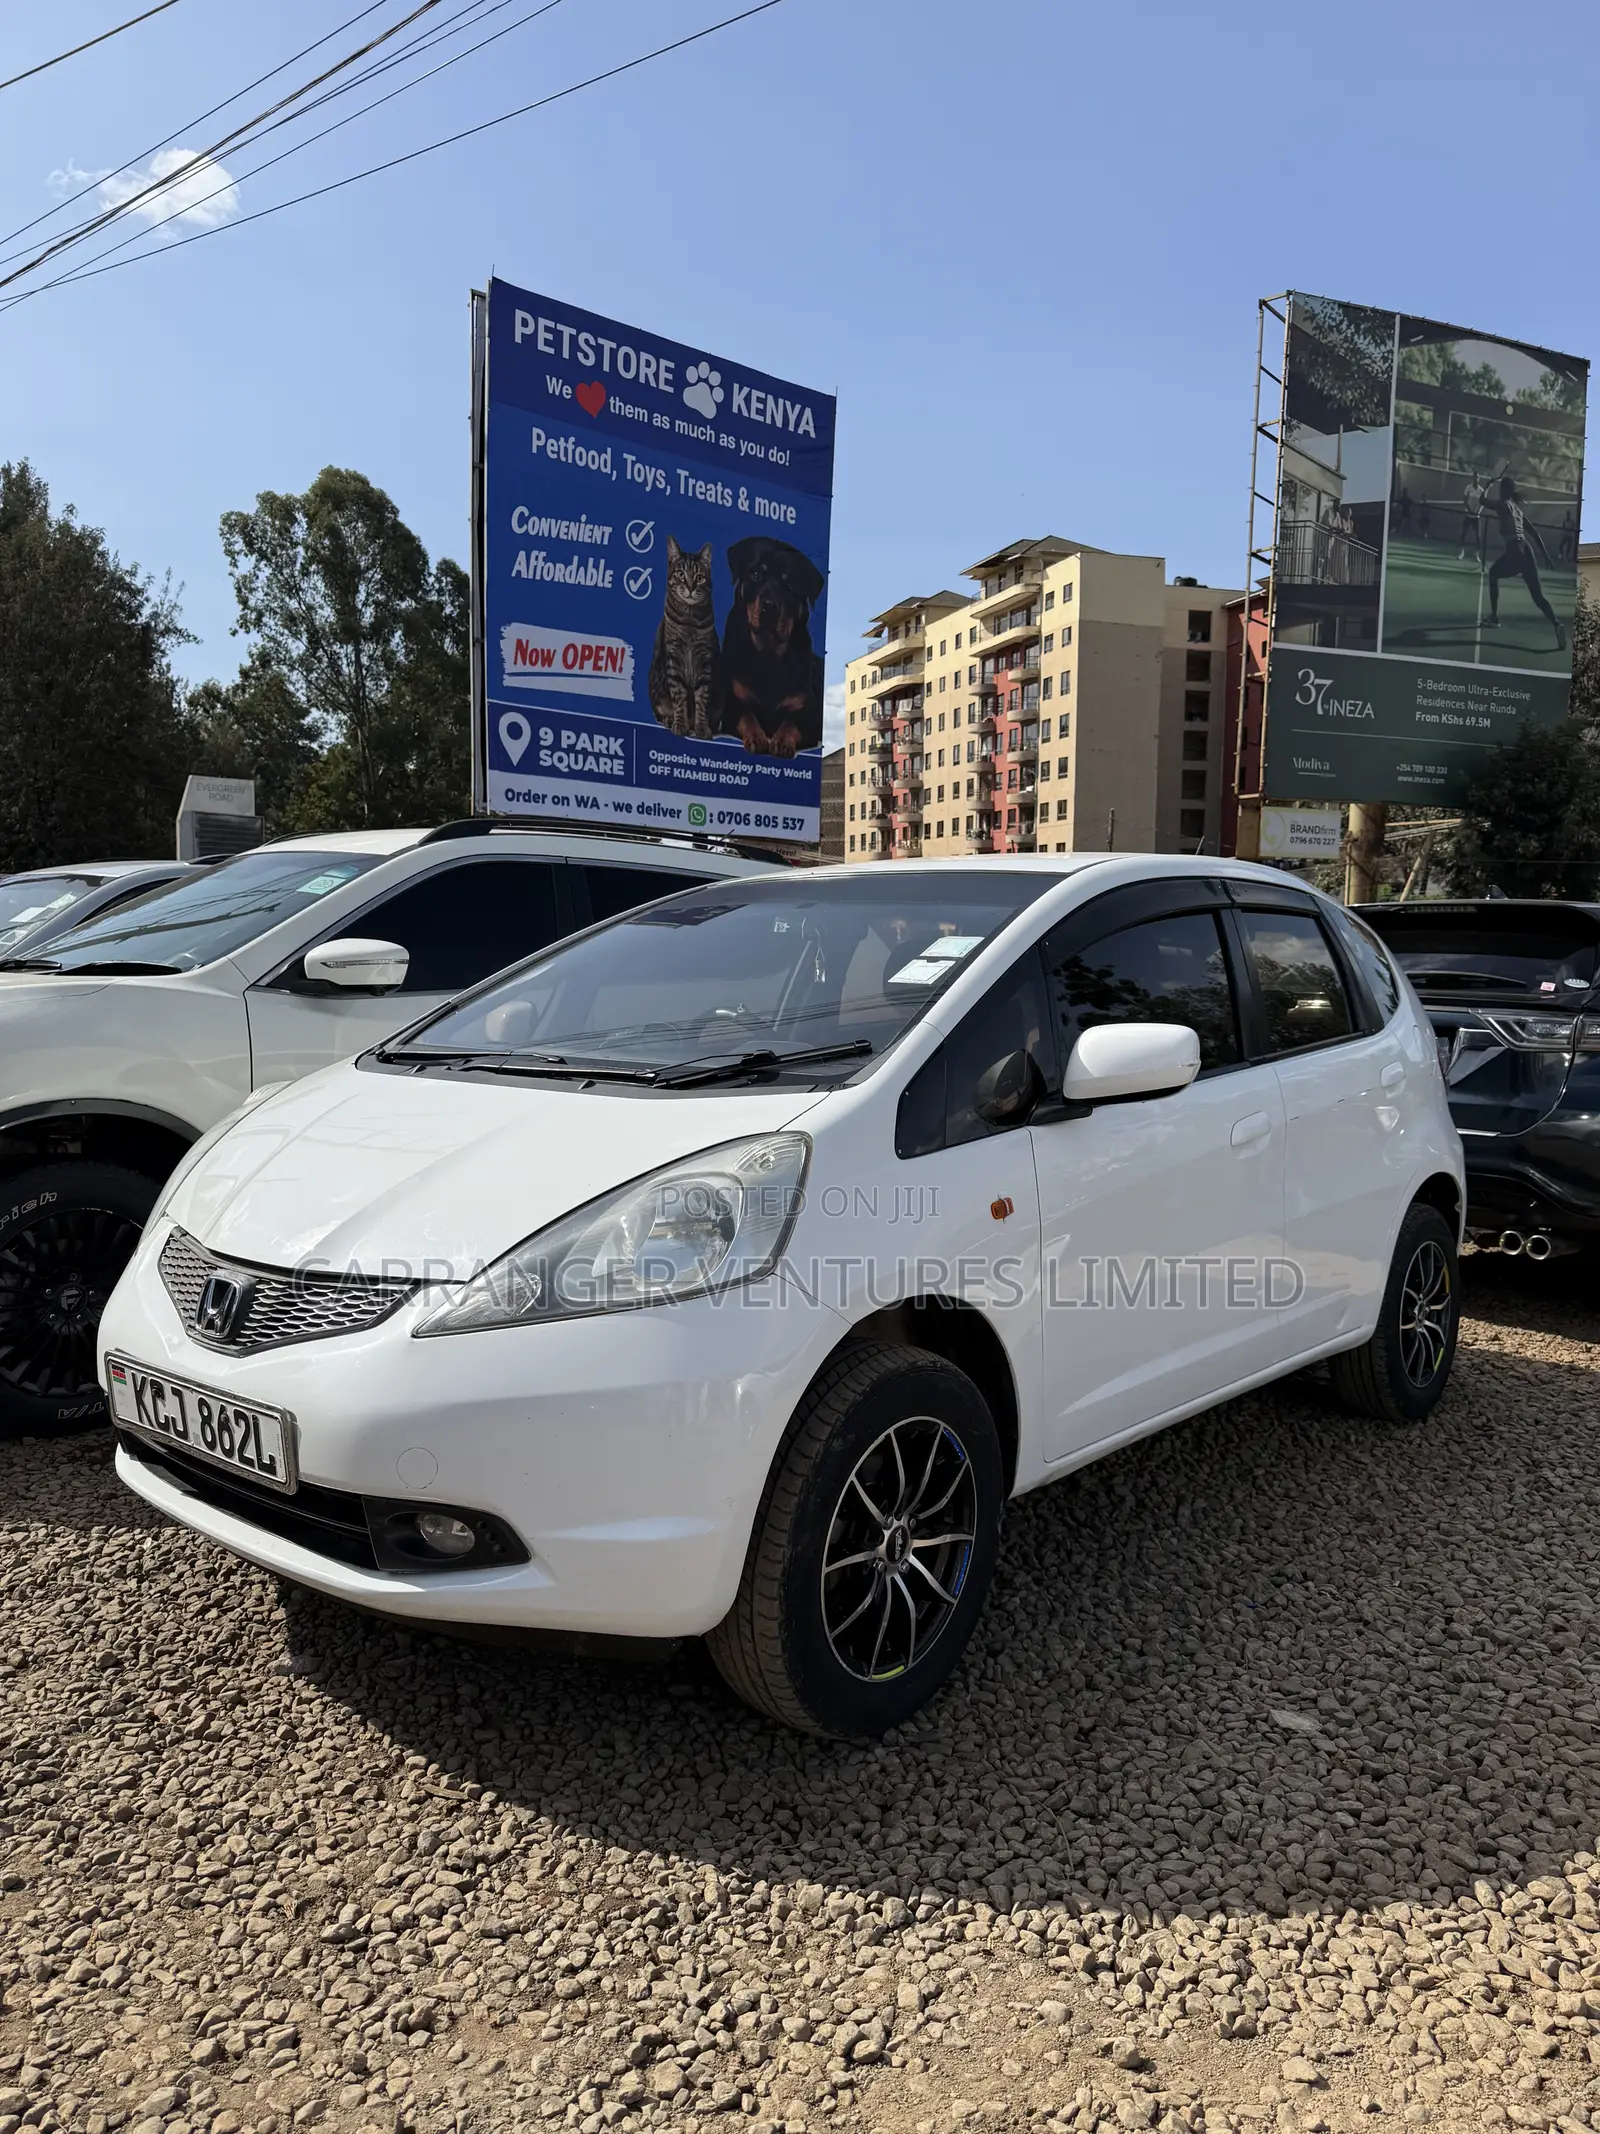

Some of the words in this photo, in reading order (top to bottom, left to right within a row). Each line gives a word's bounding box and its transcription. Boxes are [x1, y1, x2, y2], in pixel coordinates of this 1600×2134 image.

[514, 308, 675, 393] PETSTORE
[732, 383, 816, 439] KENYA
[546, 374, 573, 400] We
[609, 395, 648, 424] them
[652, 411, 671, 429] as
[675, 418, 715, 444] much
[719, 433, 736, 450] as
[739, 438, 765, 463] you
[768, 445, 791, 467] do!
[531, 426, 617, 481] Petfood,
[623, 453, 671, 496] Toys,
[676, 468, 733, 507] Treats
[738, 487, 749, 512] &
[755, 496, 797, 525] more
[562, 644, 625, 674] OPEN!
[1295, 668, 1334, 715] 37
[1417, 679, 1466, 693] 5-Bedroom
[1468, 684, 1531, 700] Ultra-Exclusive
[1329, 699, 1375, 719] INEZA
[1416, 695, 1466, 710] Residences
[1467, 700, 1488, 711] Near
[1490, 702, 1517, 715] Runda
[1415, 711, 1439, 723] From
[1441, 713, 1464, 726] KShs
[1465, 716, 1491, 728] 69.5M
[539, 726, 554, 746] 9
[561, 730, 625, 757] PARK
[539, 750, 625, 776] SQUARE
[649, 750, 697, 766] Opposite
[699, 757, 754, 774] Wanderjoy
[755, 764, 782, 780] Party
[784, 768, 812, 780] World
[649, 764, 671, 776] OFF
[673, 767, 717, 784] KIAMBU
[719, 773, 749, 786] ROAD
[196, 782, 246, 795] EVERGREEN
[208, 792, 234, 802] ROAD
[504, 788, 548, 805] Order
[551, 795, 571, 807] on
[574, 795, 600, 810] WA
[612, 801, 633, 814] we
[637, 802, 682, 819] deliver
[717, 810, 750, 827] 0706
[755, 813, 779, 829] 805
[782, 817, 805, 831] 537
[1290, 824, 1336, 835] BRANDfirm
[1290, 836, 1308, 844] 0796
[1308, 837, 1321, 845] 670
[131, 1372, 189, 1441] KCJ
[197, 1396, 277, 1476] 862L
